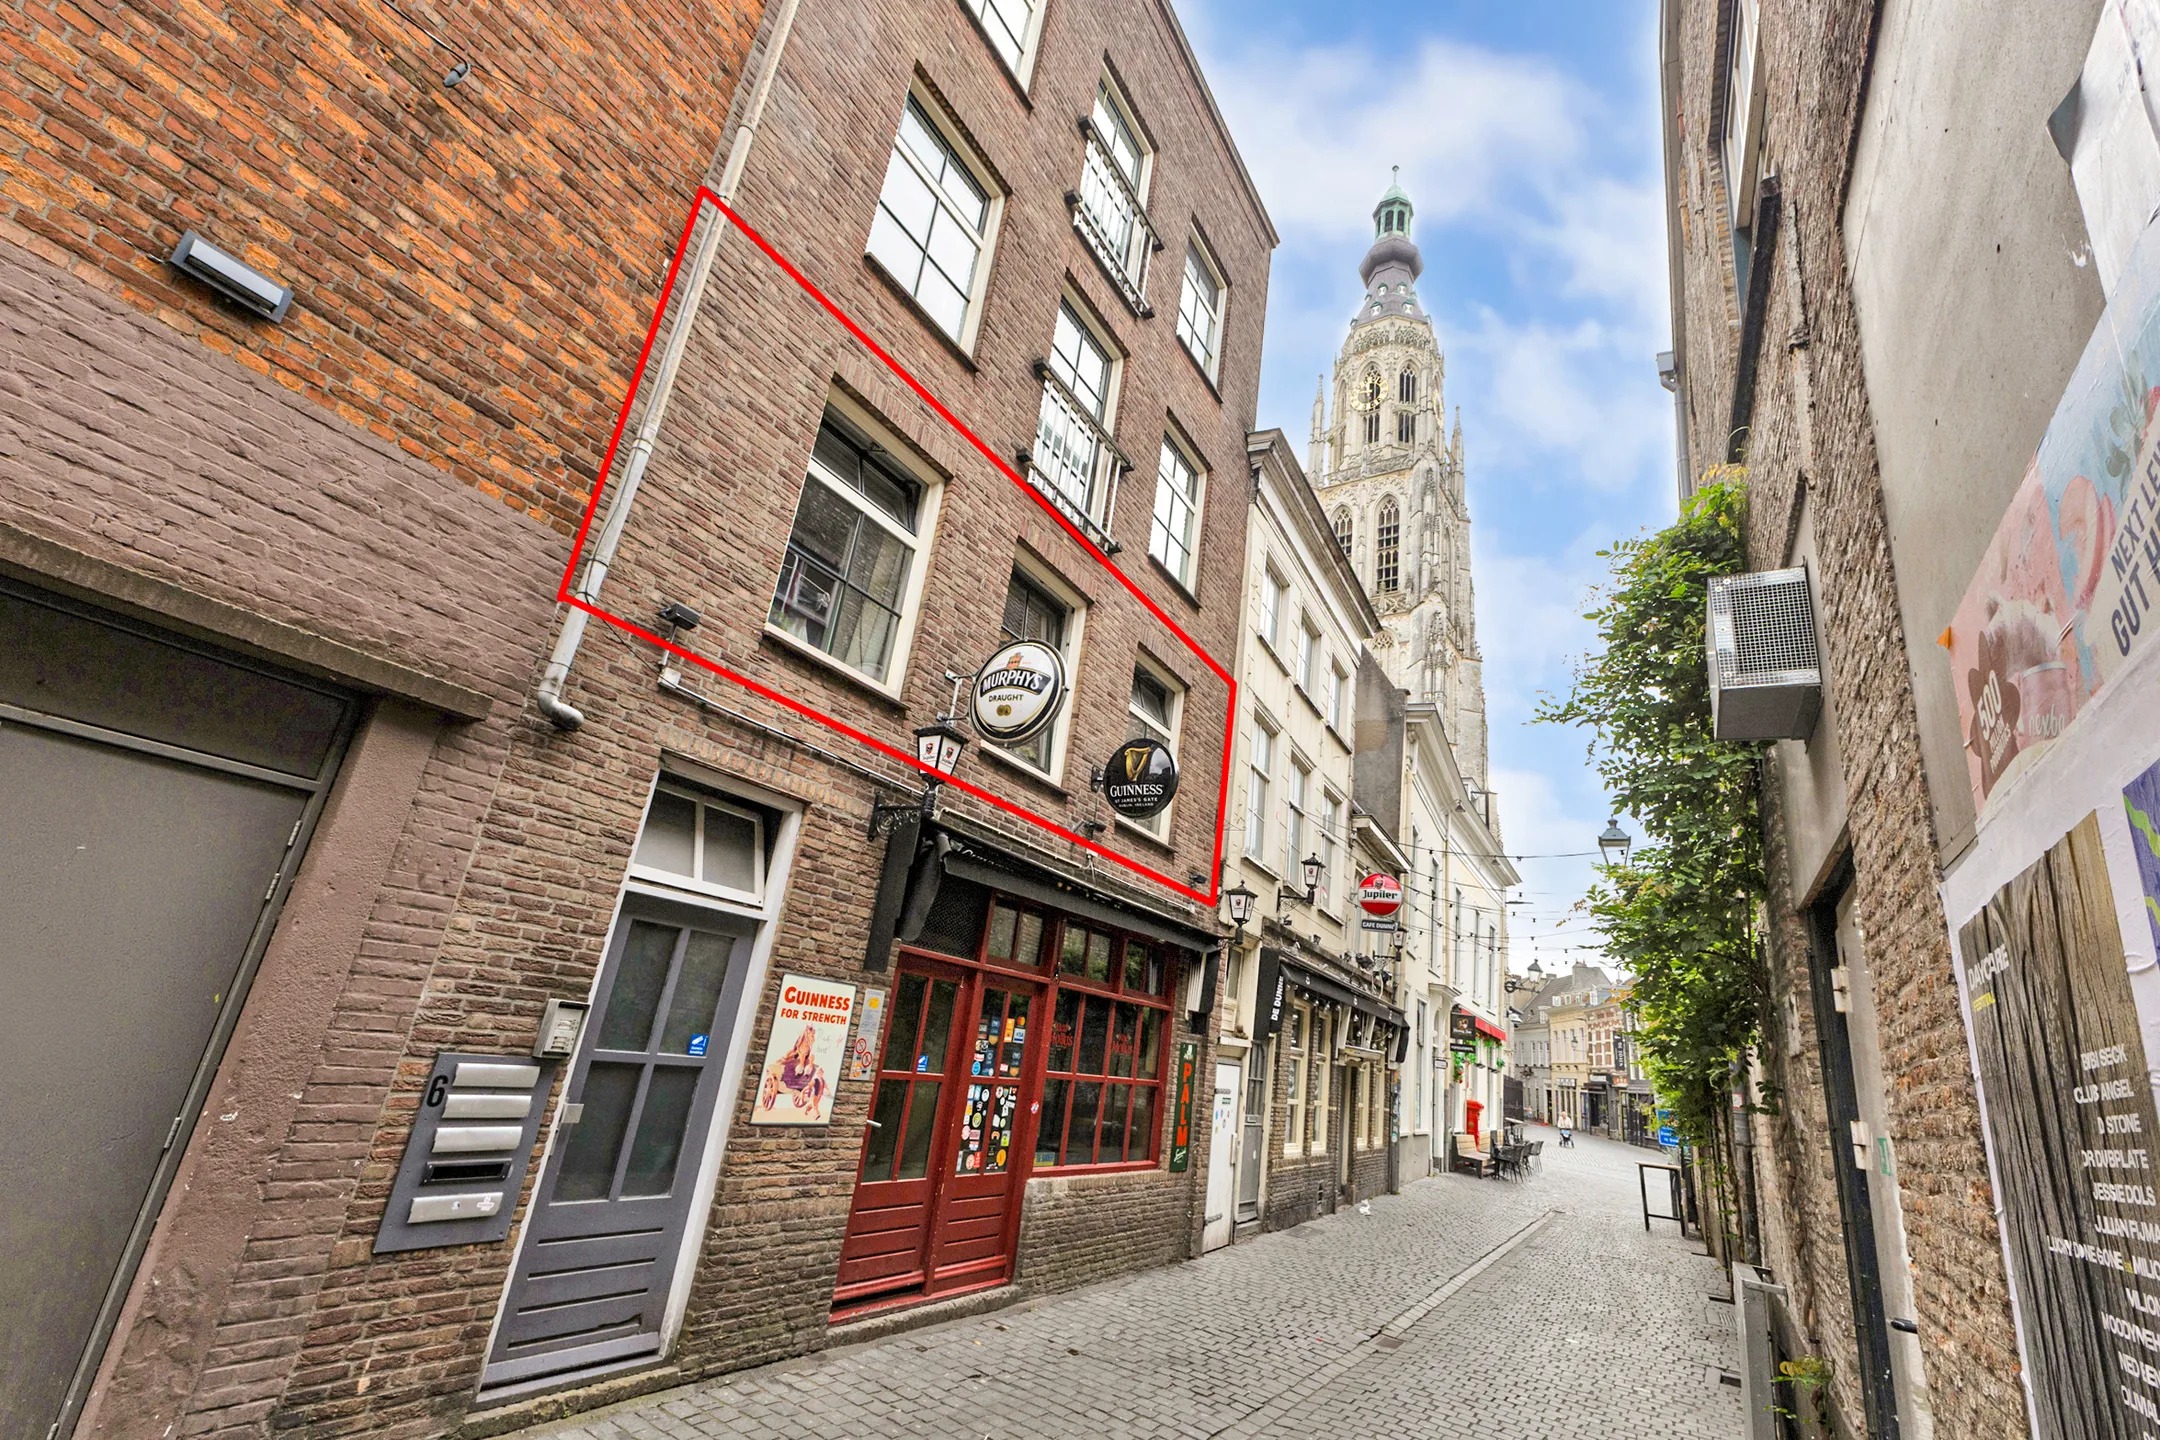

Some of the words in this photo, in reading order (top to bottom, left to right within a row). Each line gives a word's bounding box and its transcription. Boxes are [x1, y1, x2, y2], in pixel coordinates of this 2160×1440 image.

[2111, 498, 2145, 583] NEXT
[2111, 561, 2150, 657] GUT
[988, 694, 1024, 702] DRAUGHT
[1977, 669, 2002, 740] 500
[1110, 784, 1163, 797] GUINNESS
[1363, 889, 1398, 900] Jupiler
[1967, 944, 2009, 991] DAYCARE
[784, 986, 851, 1011] GUINNESS
[1273, 975, 1284, 1007] DUNNE
[780, 1008, 798, 1019] FOR
[801, 1010, 847, 1025] STRENGTH
[1271, 1007, 1280, 1021] DE
[2081, 1051, 2100, 1071] BIBI
[2100, 1043, 2128, 1067] SECK
[426, 1074, 449, 1107] 6
[2073, 1084, 2100, 1104] CLUB
[2101, 1079, 2134, 1100] ANGEL
[1176, 1062, 1192, 1147] PALM
[2097, 1116, 2105, 1134] D
[2105, 1113, 2142, 1134] STONE
[2096, 1149, 2149, 1168] DUBPLATE
[2093, 1182, 2126, 1202] JESSIE
[2125, 1185, 2156, 1206] DOLS
[2097, 1249, 2124, 1271] GONE
